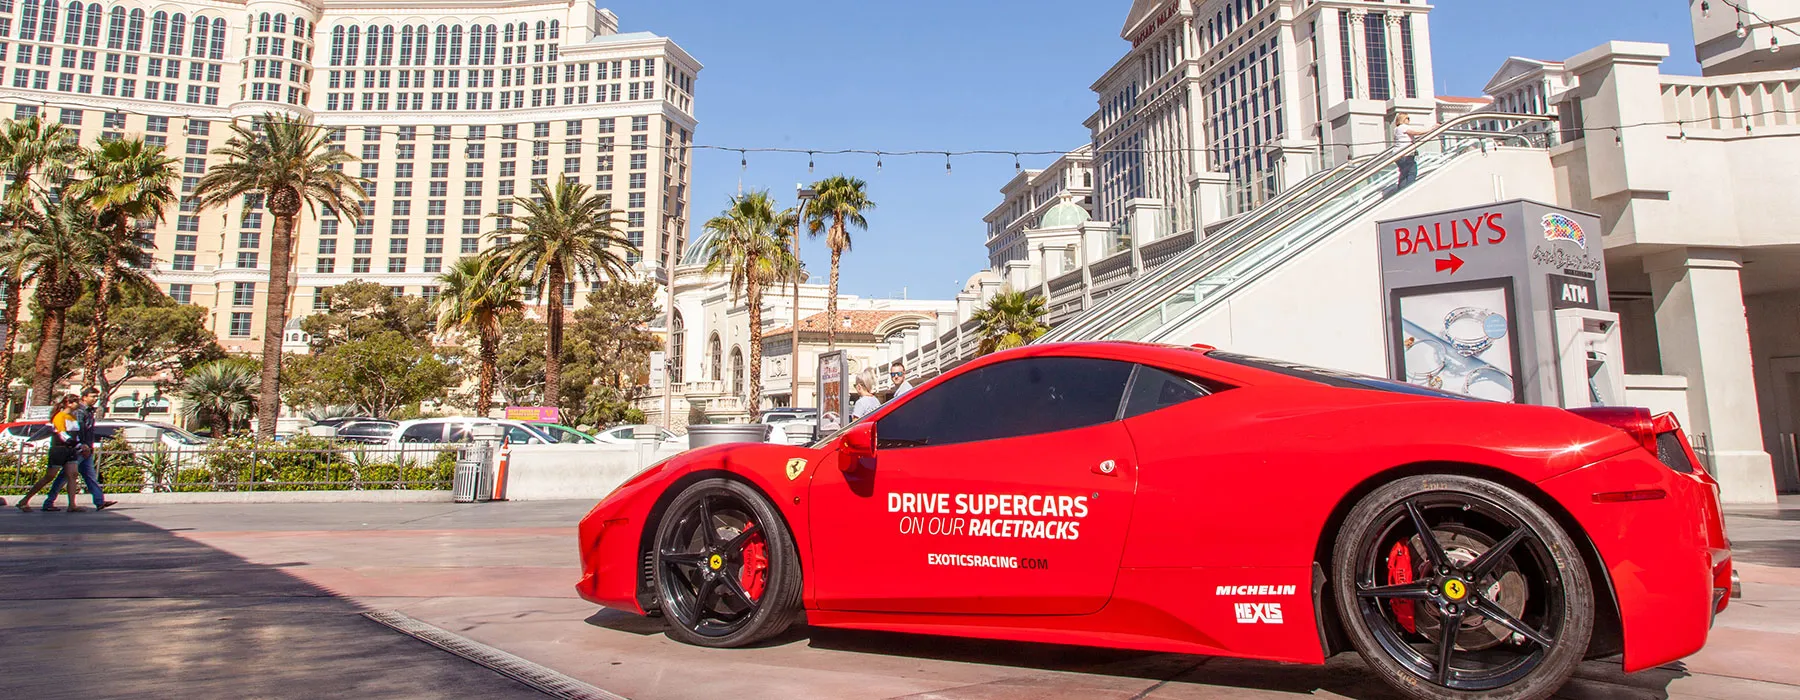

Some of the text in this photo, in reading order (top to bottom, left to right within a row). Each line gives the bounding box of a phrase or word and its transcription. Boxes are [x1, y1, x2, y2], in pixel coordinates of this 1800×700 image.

[1395, 212, 1507, 257] BALLY'S
[1562, 283, 1589, 304] ATM
[887, 492, 1089, 518] DRIVE SUPERCARS
[899, 516, 1080, 540] ON OUR RACETRACKS
[927, 553, 1049, 570] EXOTICSRACING.COM
[1215, 585, 1297, 596] MICHELIN
[1233, 602, 1284, 624] HEXIS
